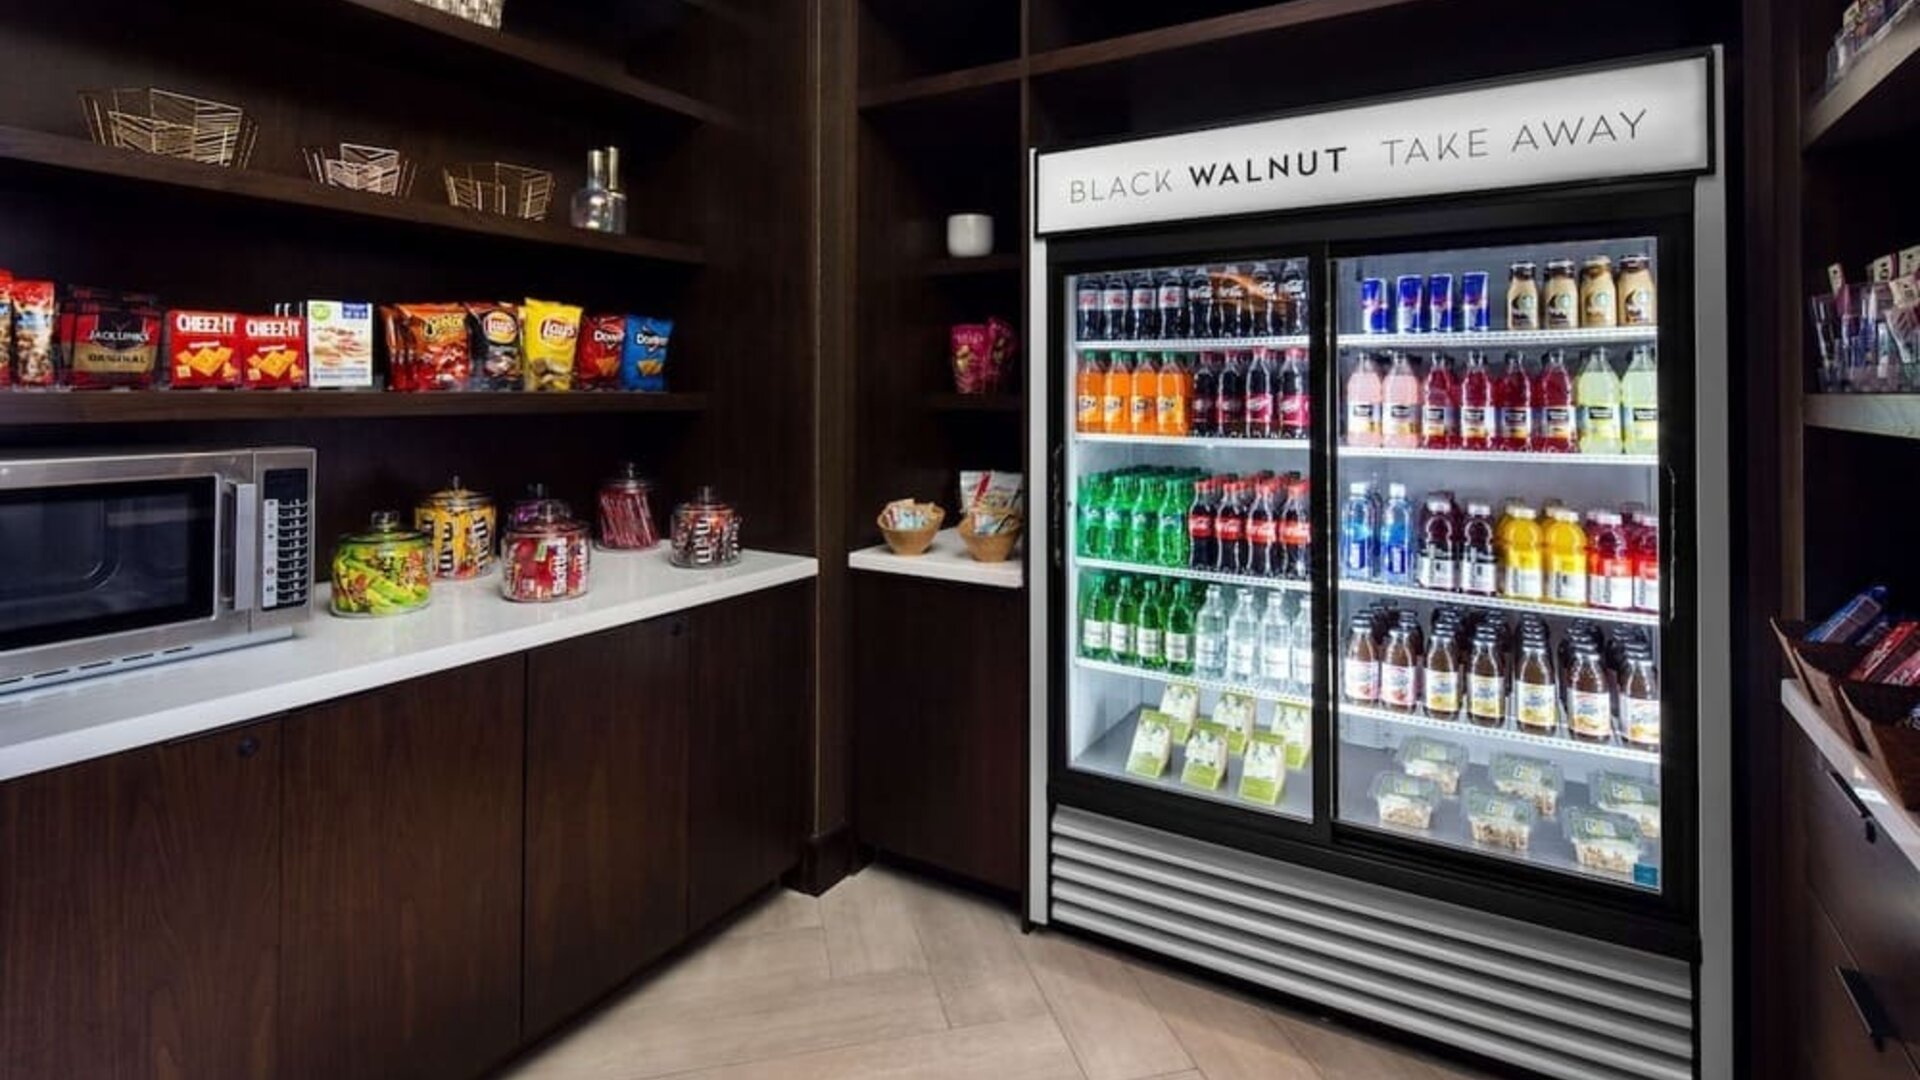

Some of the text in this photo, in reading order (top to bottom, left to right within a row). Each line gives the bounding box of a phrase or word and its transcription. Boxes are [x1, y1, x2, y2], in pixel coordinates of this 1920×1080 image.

[1070, 108, 1648, 204] BLACK WALNUT TAKE AWAY
[176, 314, 238, 335] CHEEZ-IT
[245, 319, 302, 338] CHEEZ-IT
